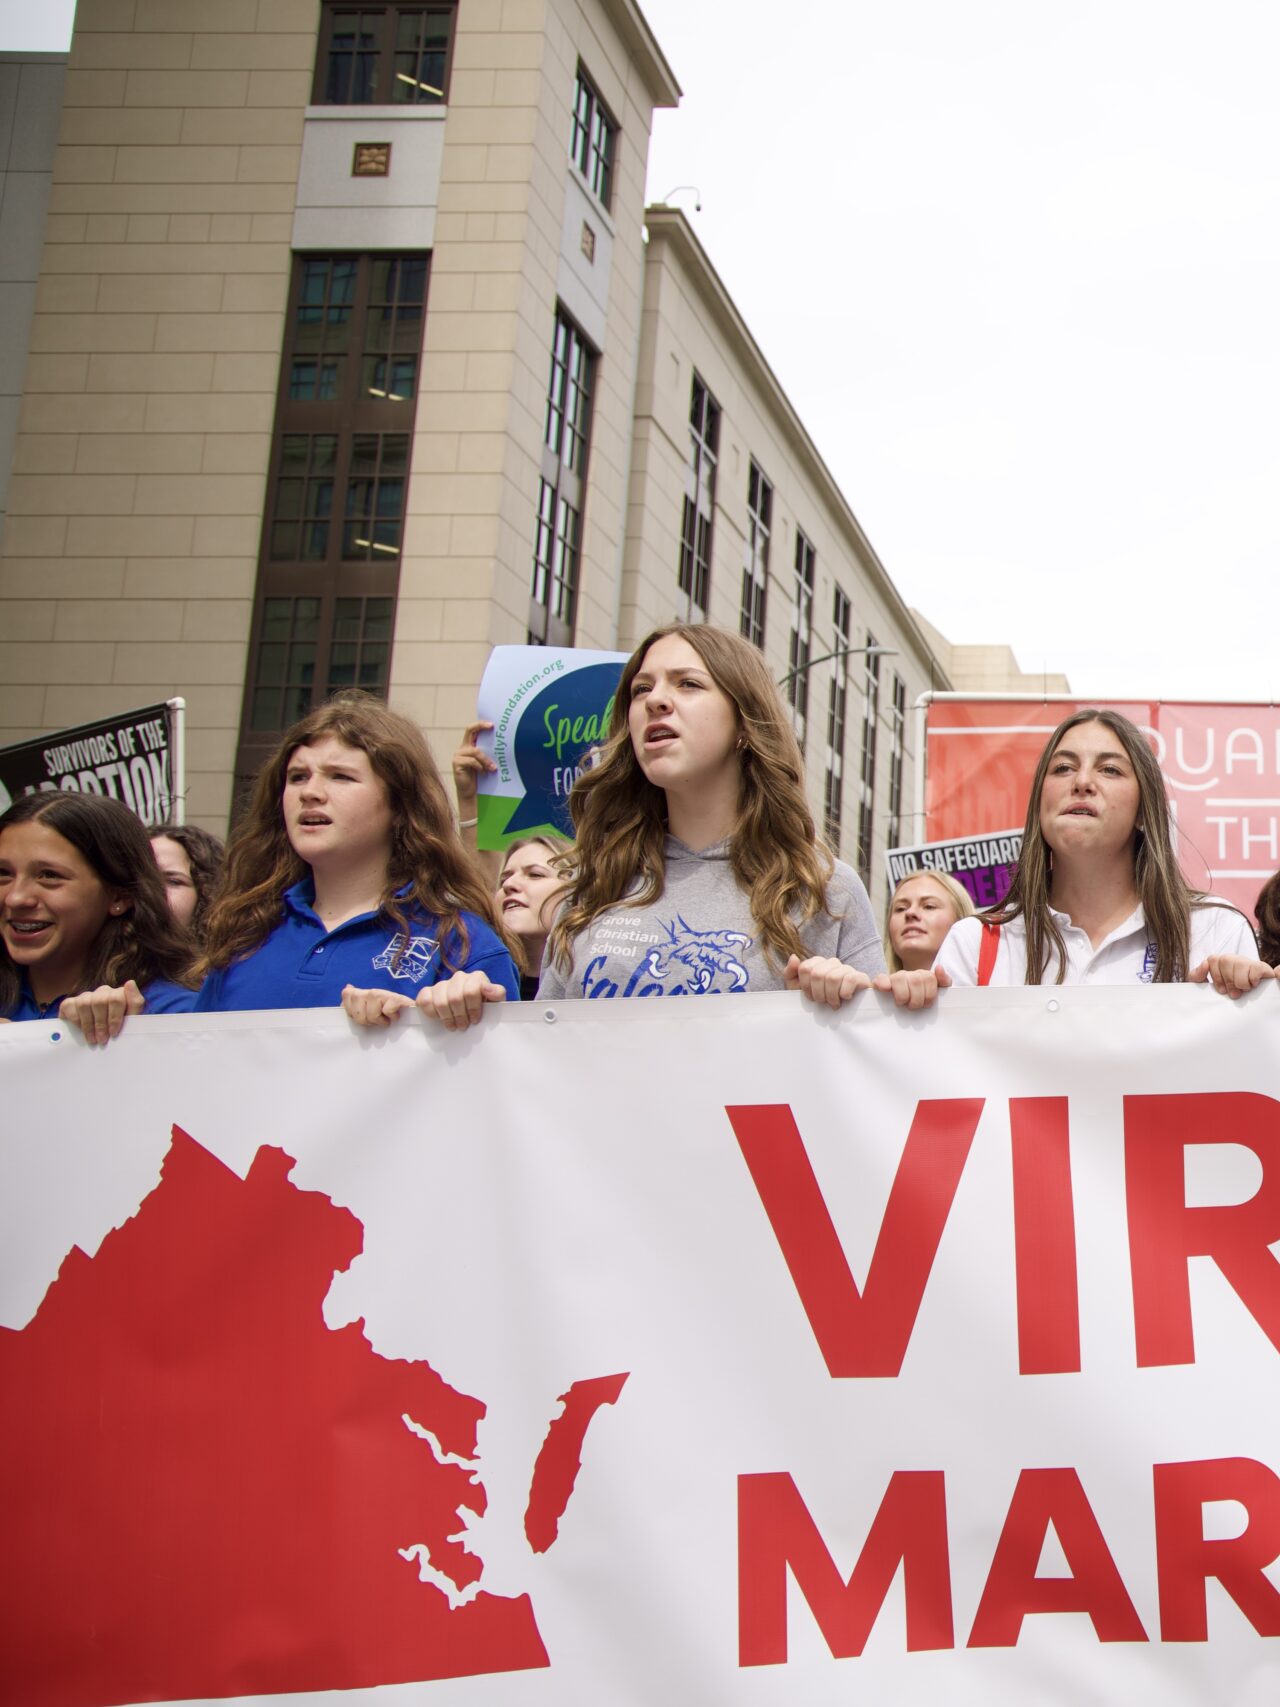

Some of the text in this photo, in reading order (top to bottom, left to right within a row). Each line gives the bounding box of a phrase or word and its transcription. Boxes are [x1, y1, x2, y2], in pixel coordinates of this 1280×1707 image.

[494, 659, 565, 784] FamilyFoundation.org
[43, 719, 167, 777] SURVIVORS OF THE
[890, 836, 1022, 880] NO SAFEGUARD
[595, 928, 659, 944] Christian
[601, 915, 641, 927] Grove
